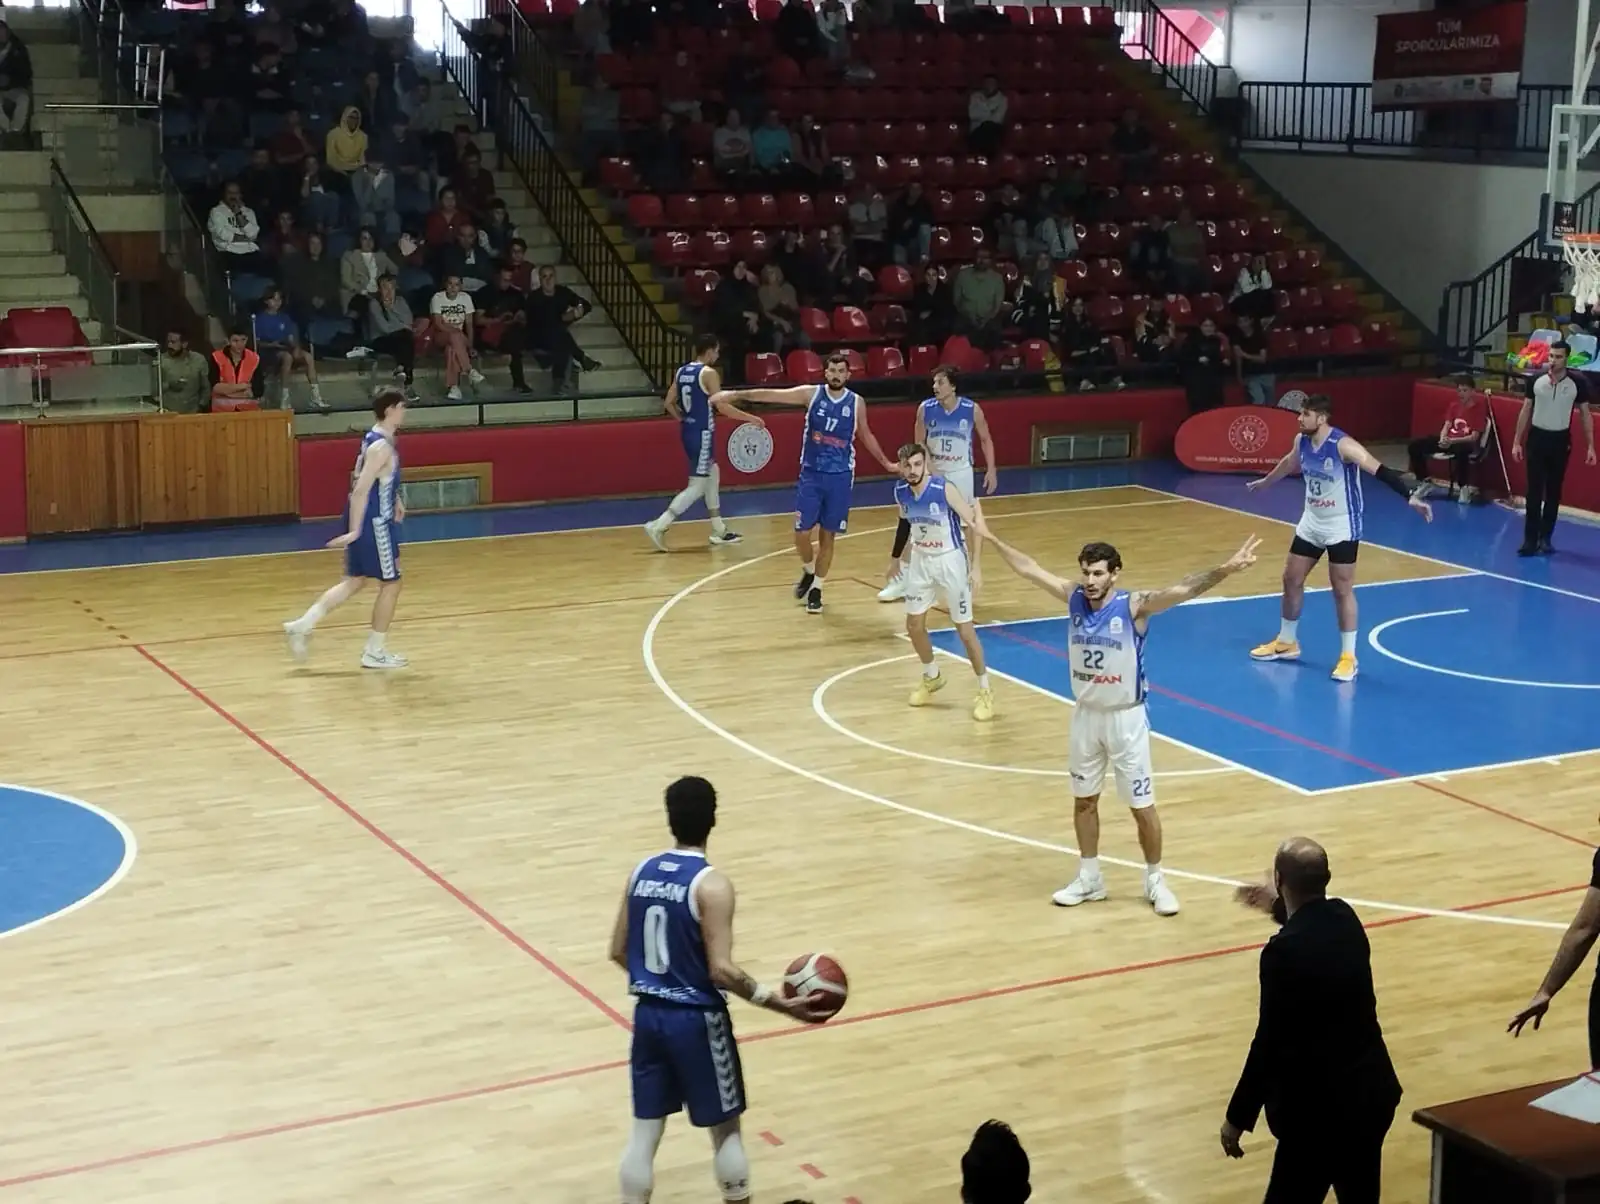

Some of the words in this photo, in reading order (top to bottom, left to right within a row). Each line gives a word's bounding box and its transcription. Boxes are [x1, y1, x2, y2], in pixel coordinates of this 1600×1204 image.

[1436, 19, 1462, 34] TÜM
[1395, 34, 1500, 53] SPORCULARIMIZA
[681, 385, 692, 414] 6
[825, 417, 838, 432] 17
[941, 438, 952, 452] 15
[959, 601, 967, 614] 5
[1083, 649, 1104, 669] 22
[1132, 777, 1151, 797] 22
[643, 905, 670, 974] 0
